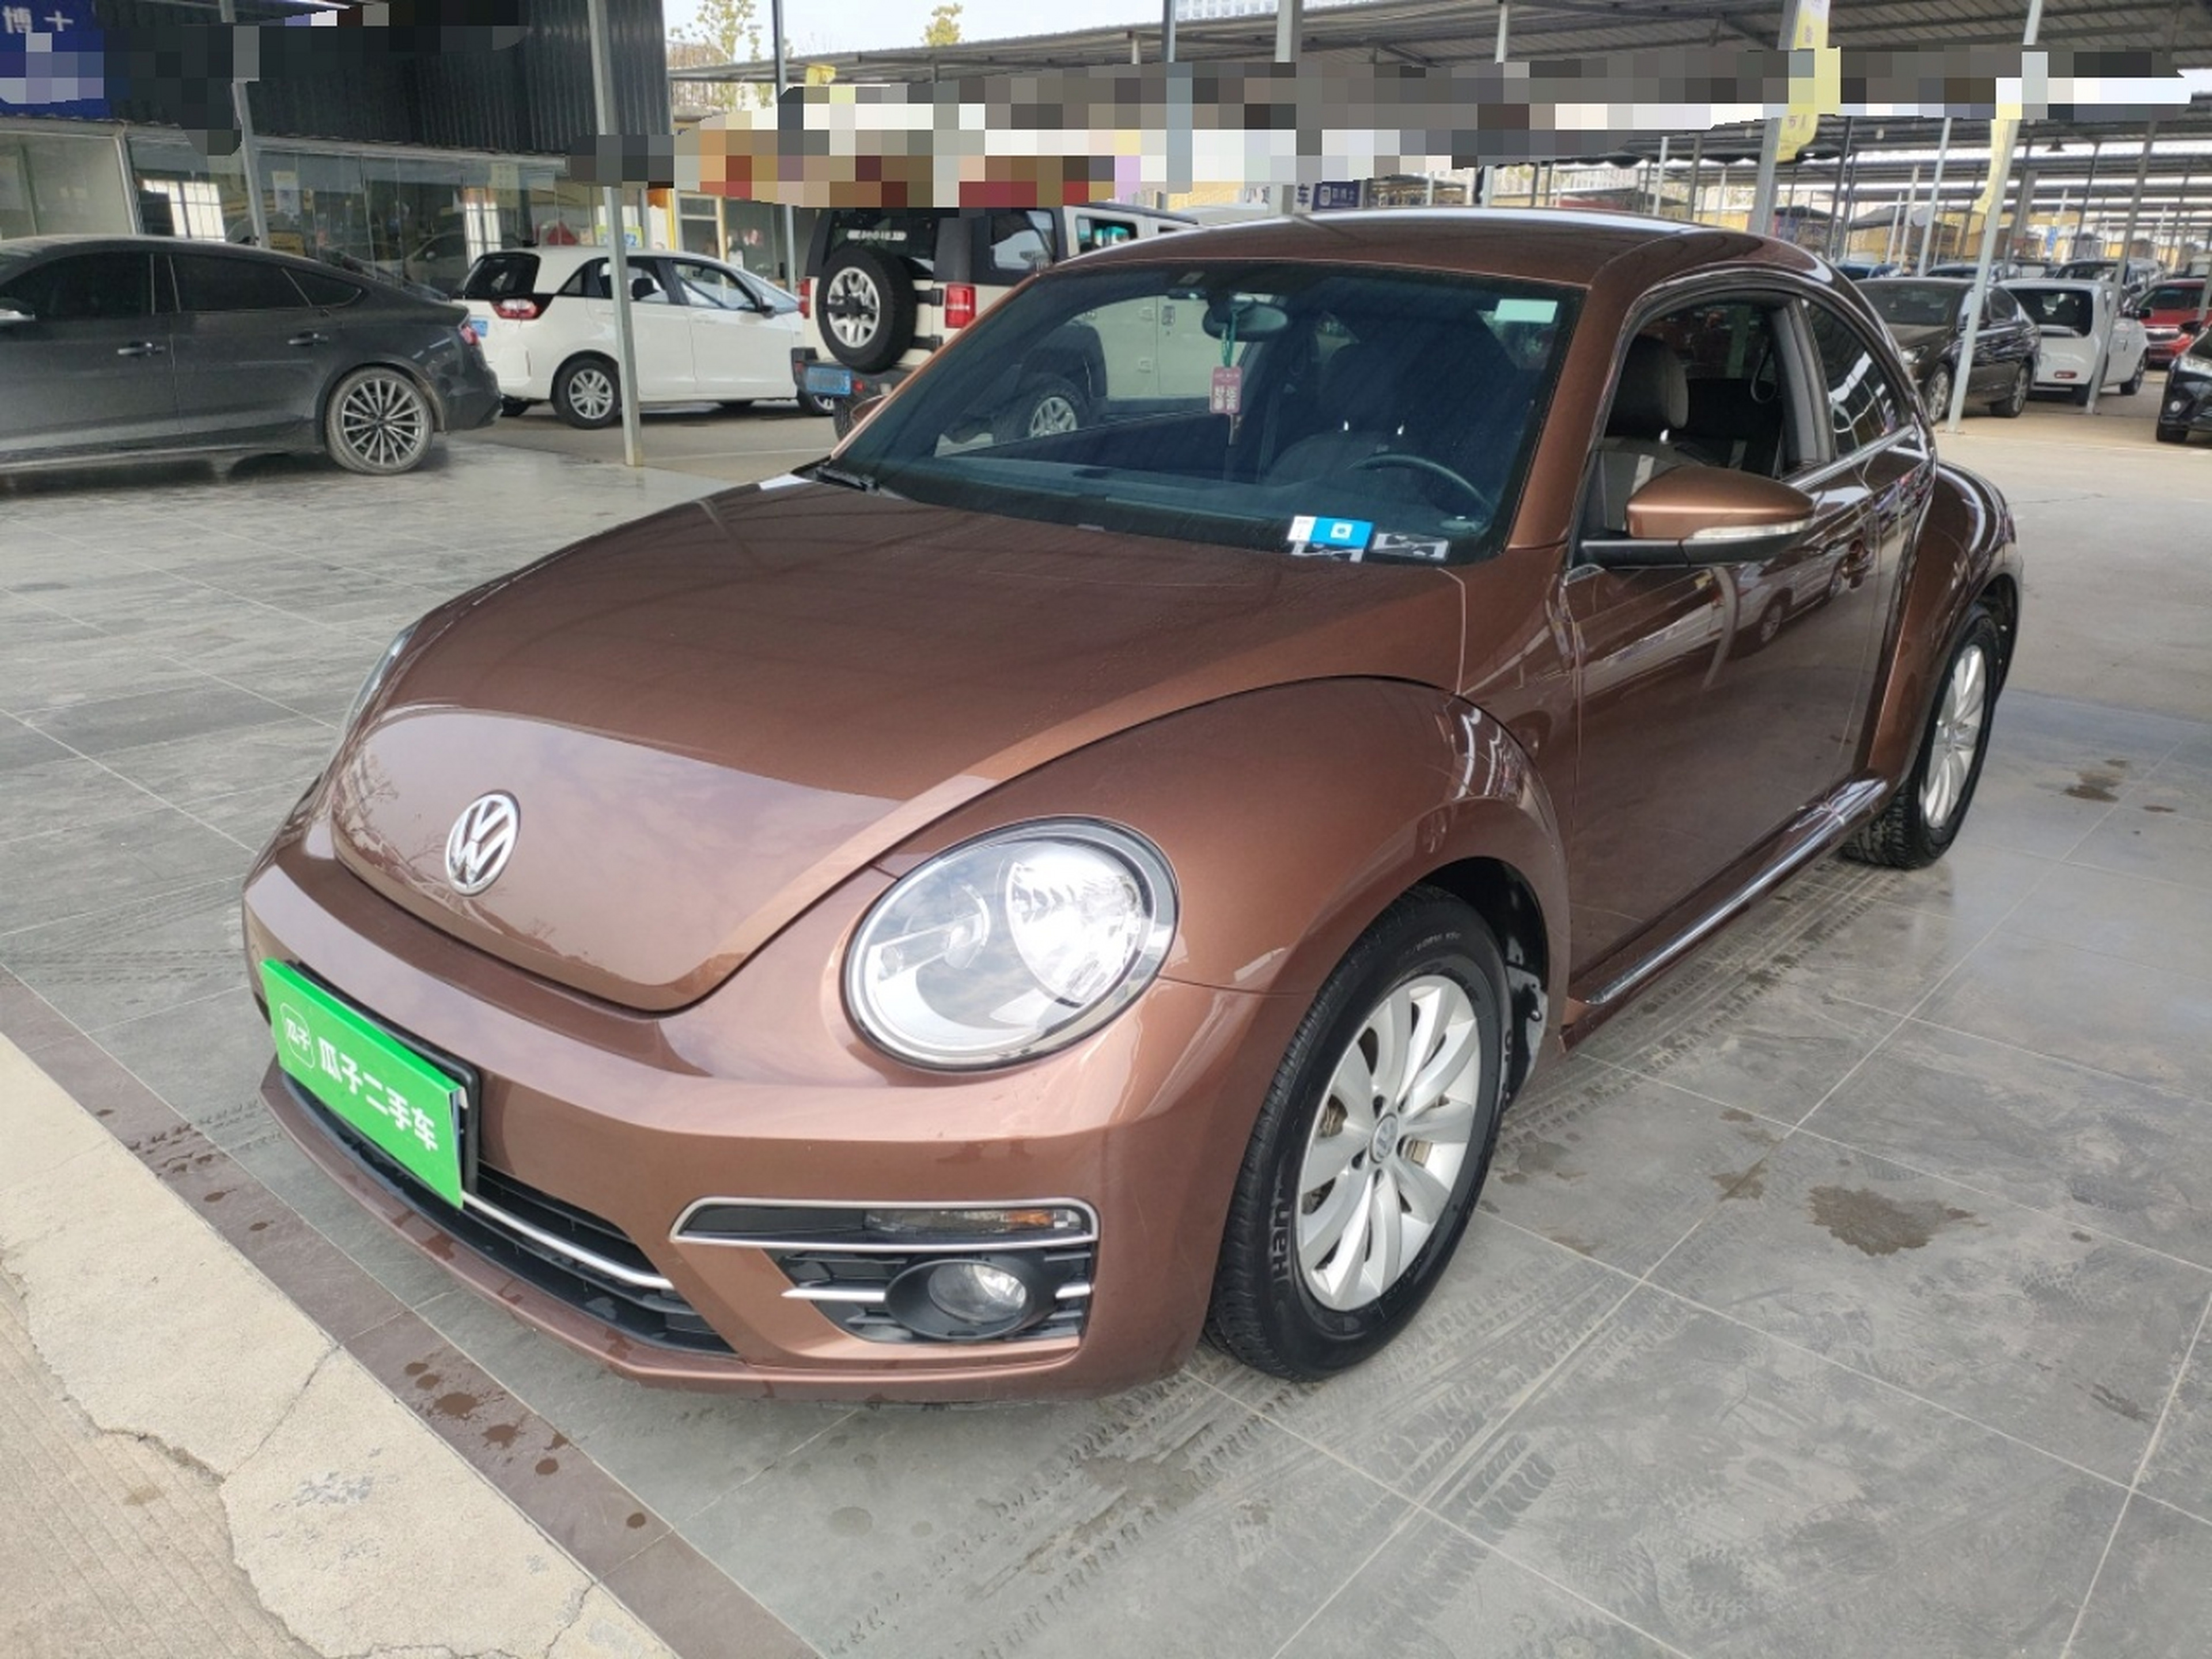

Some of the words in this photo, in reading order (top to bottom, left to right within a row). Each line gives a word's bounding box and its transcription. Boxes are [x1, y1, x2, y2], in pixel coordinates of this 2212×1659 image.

[318, 1036, 438, 1152] 瓜子二手车
